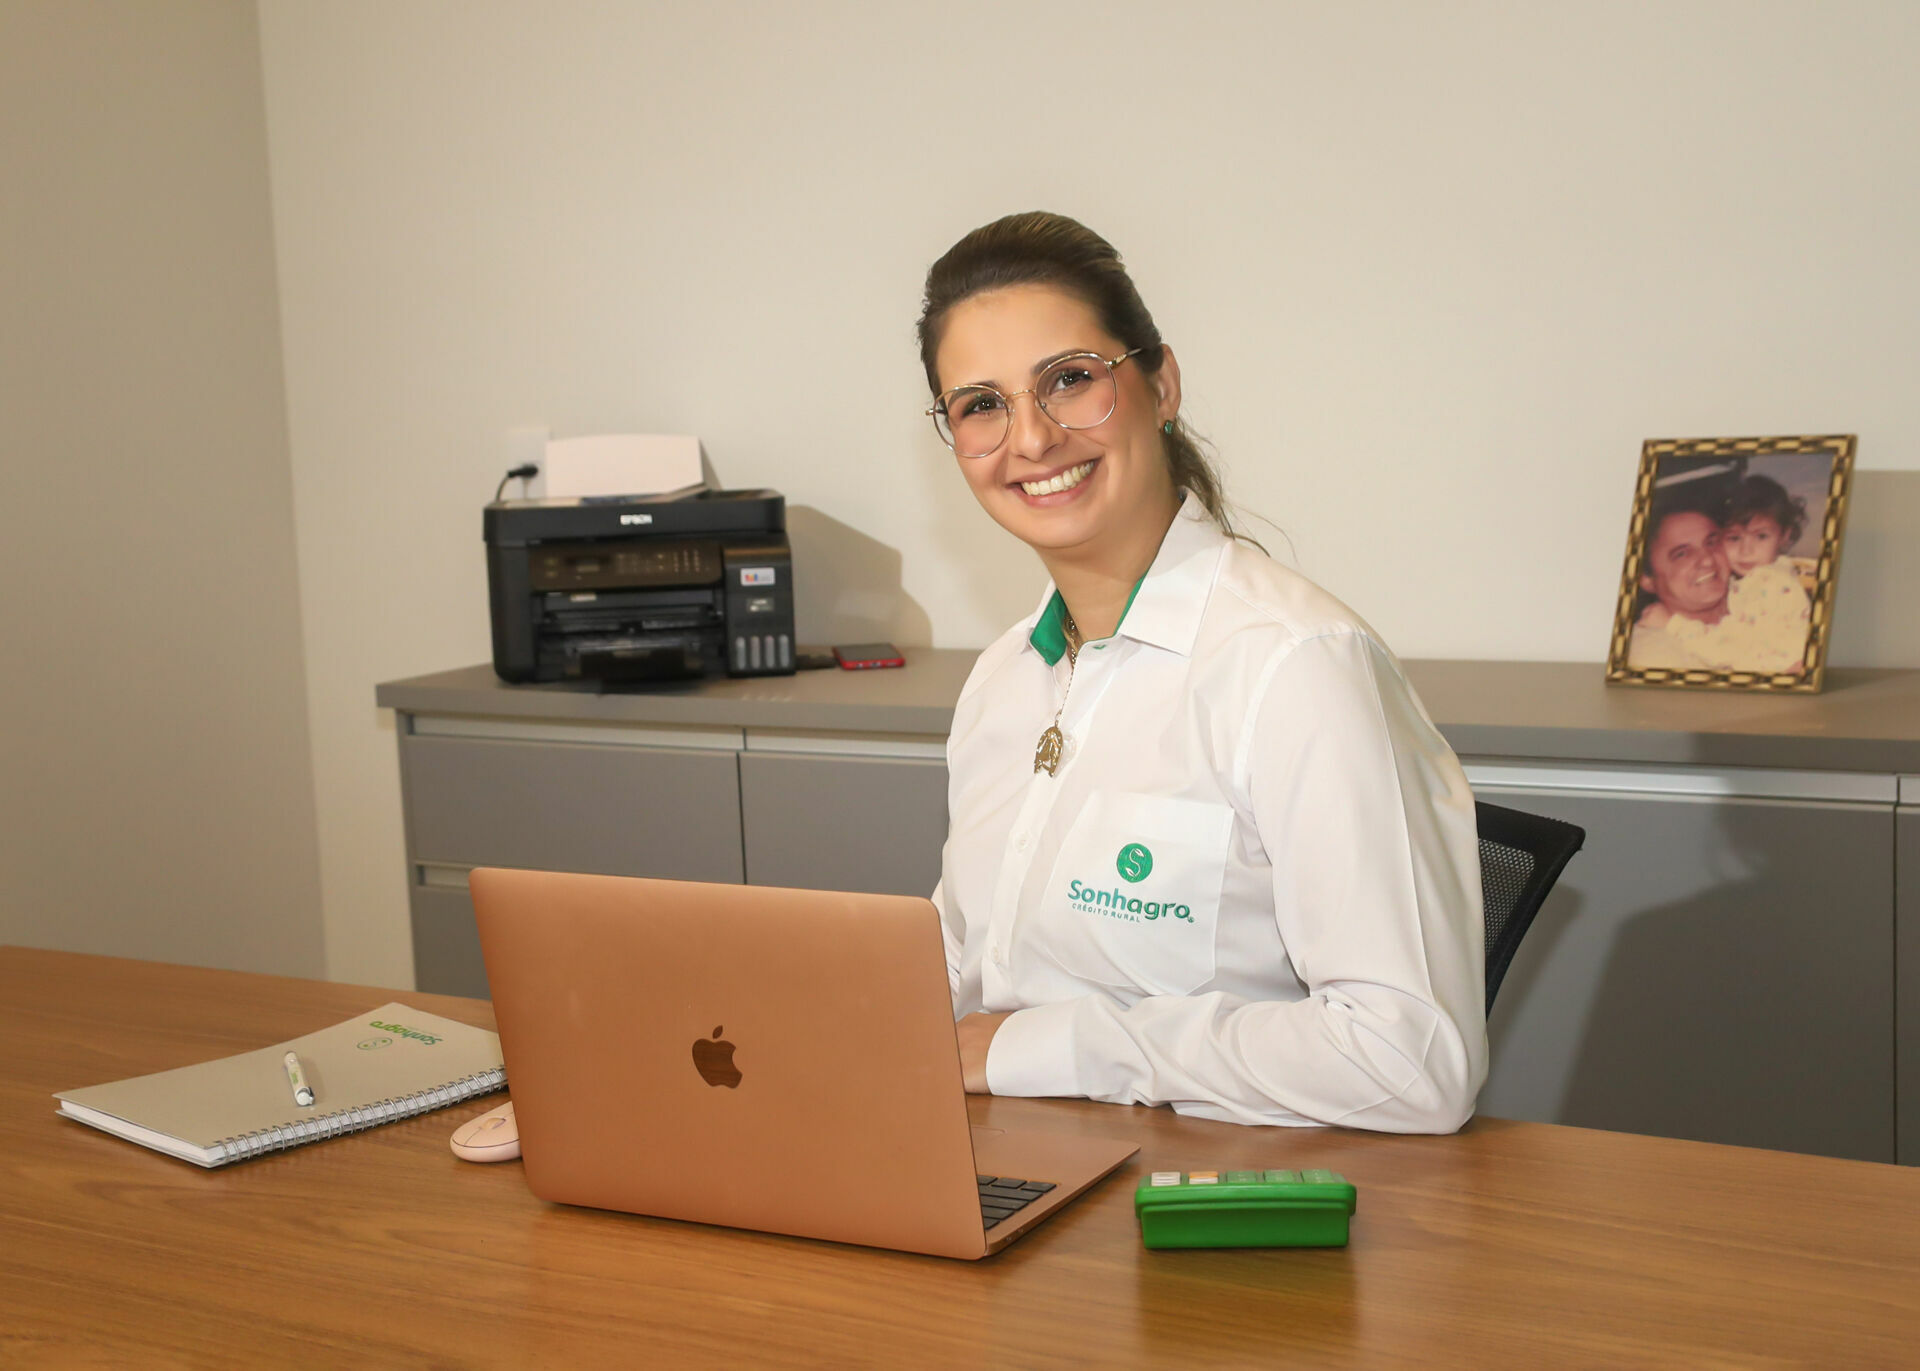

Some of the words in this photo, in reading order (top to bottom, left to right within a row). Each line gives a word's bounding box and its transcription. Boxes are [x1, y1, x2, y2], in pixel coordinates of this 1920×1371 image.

[620, 514, 653, 525] EPSON
[1071, 902, 1109, 916] CRÉDITO
[1110, 911, 1141, 923] RURAL
[370, 1021, 443, 1045] Sonhagro
